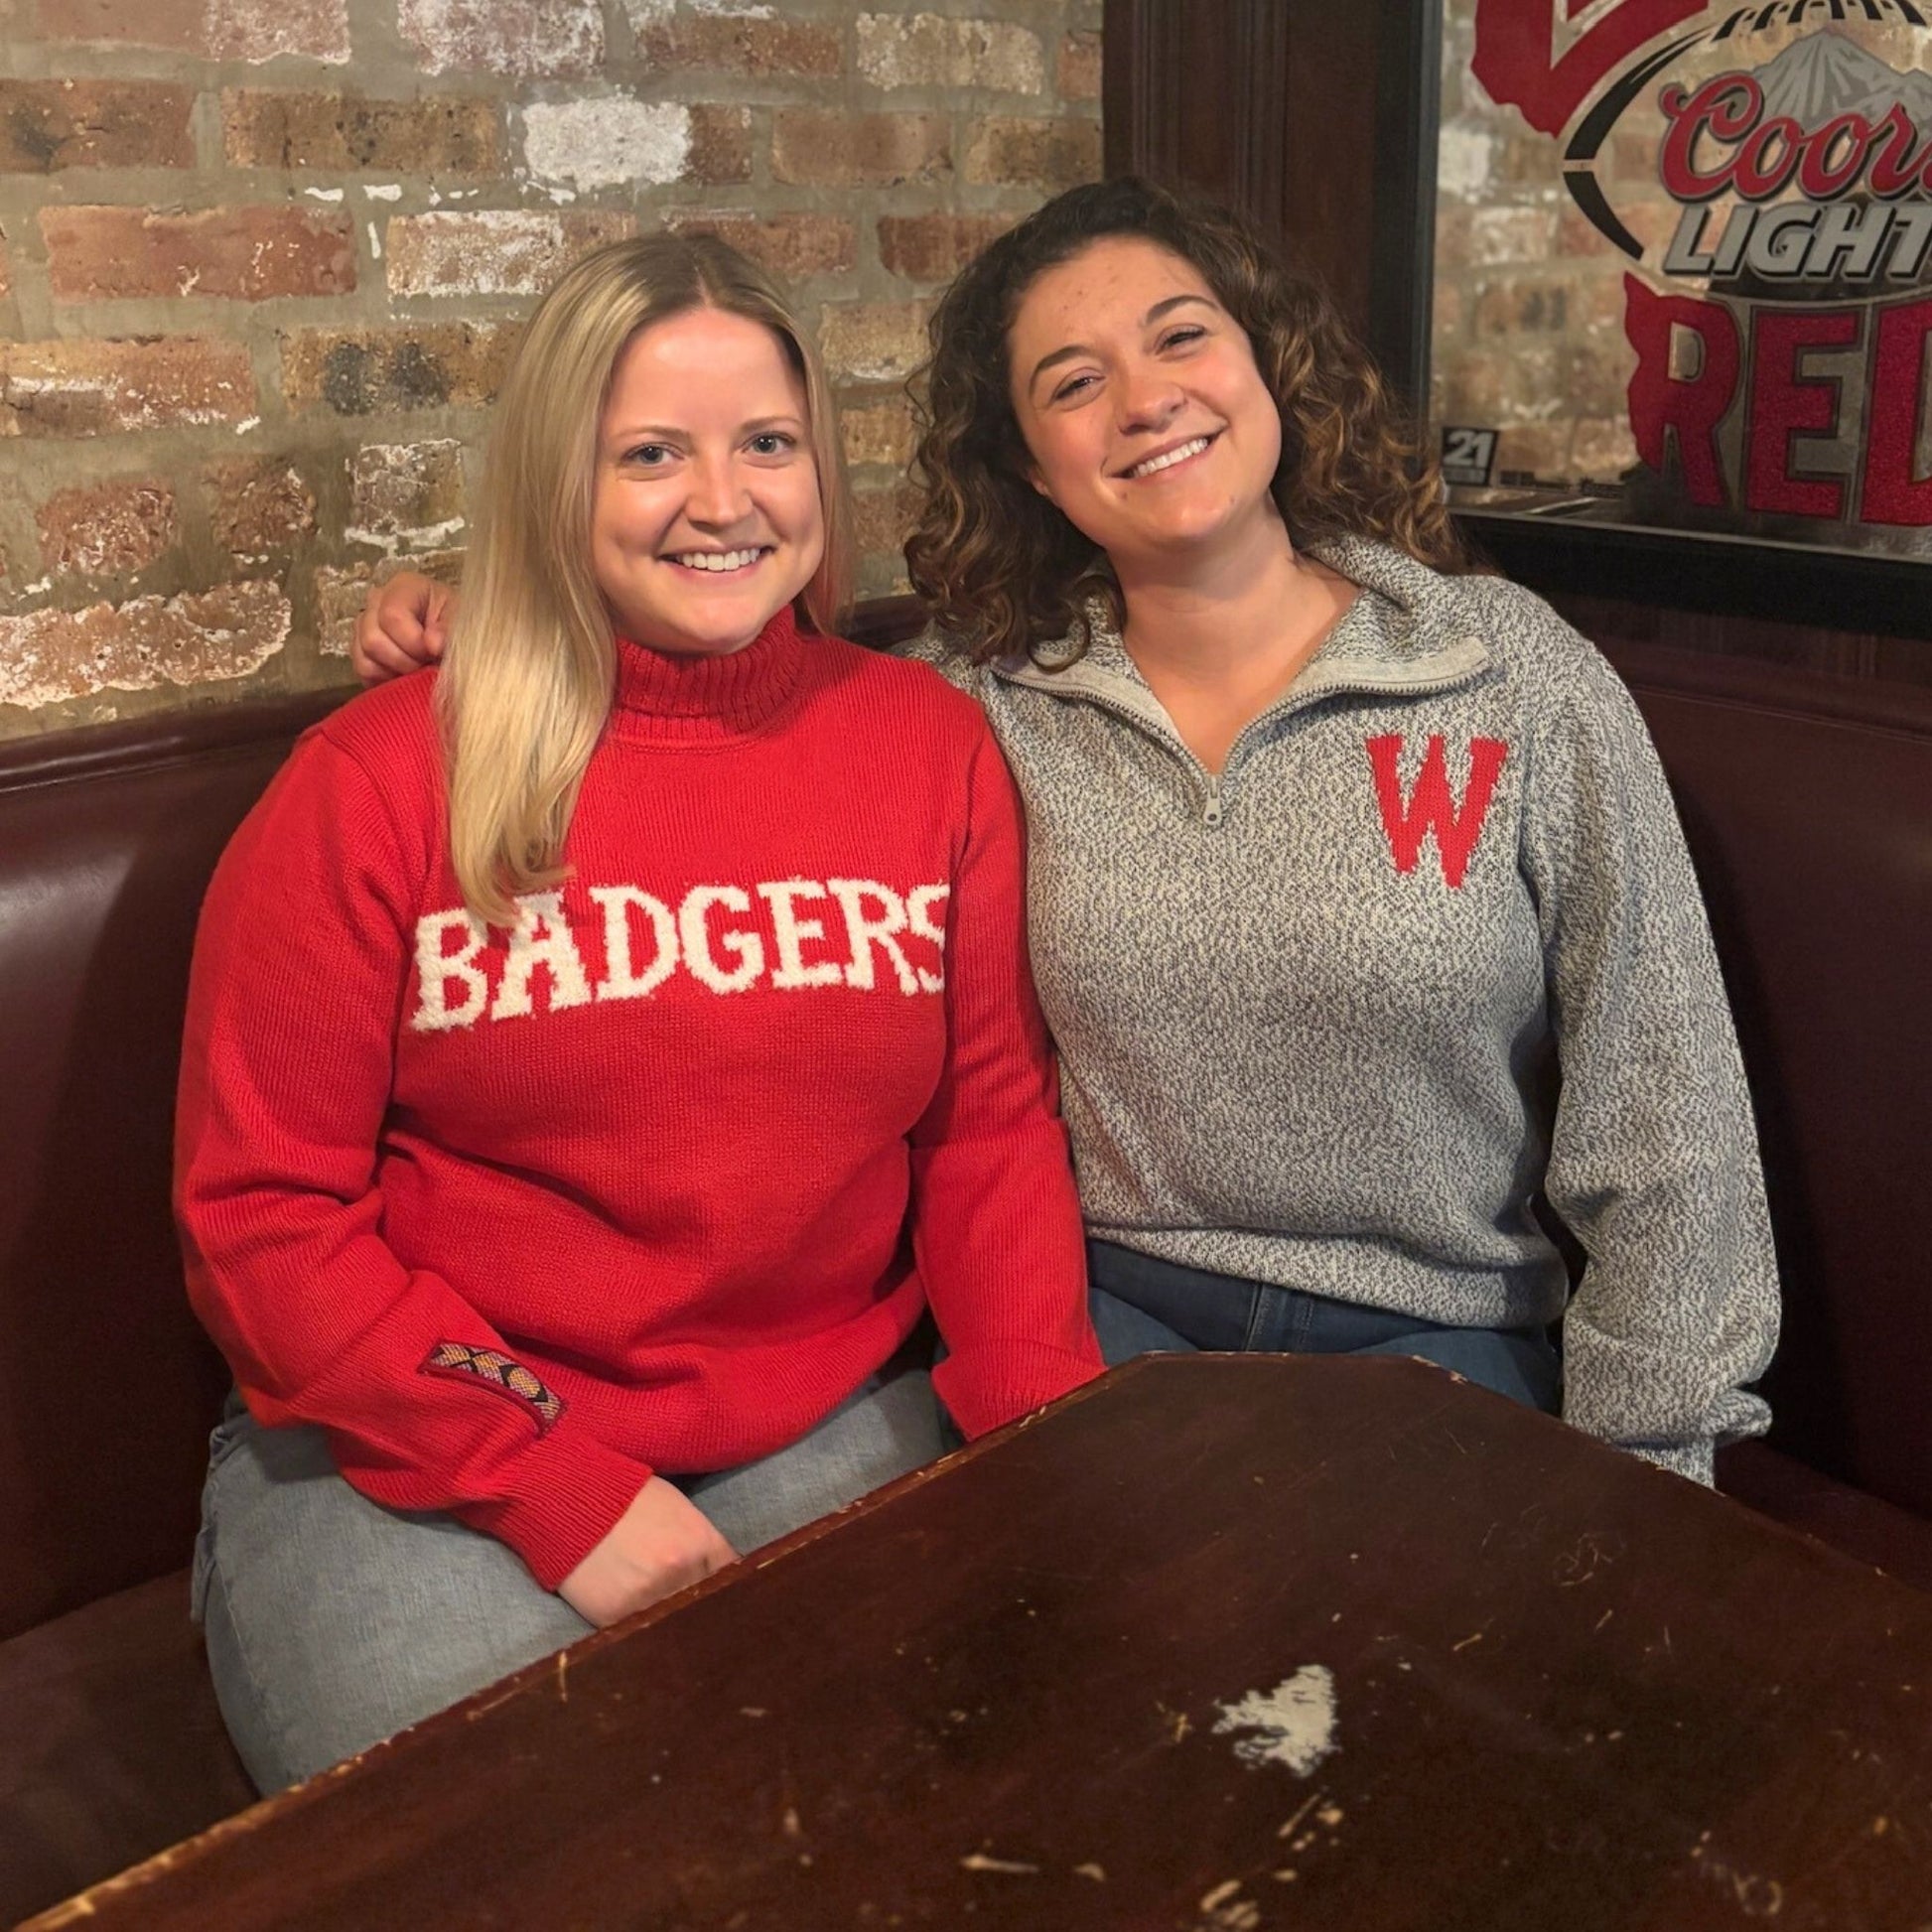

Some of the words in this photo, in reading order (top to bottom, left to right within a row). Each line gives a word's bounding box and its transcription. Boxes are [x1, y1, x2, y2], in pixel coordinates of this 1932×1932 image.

[1659, 71, 1932, 202] Coor
[1444, 430, 1494, 469] 21
[1365, 734, 1509, 889] W
[410, 877, 950, 1033] BADGERS
